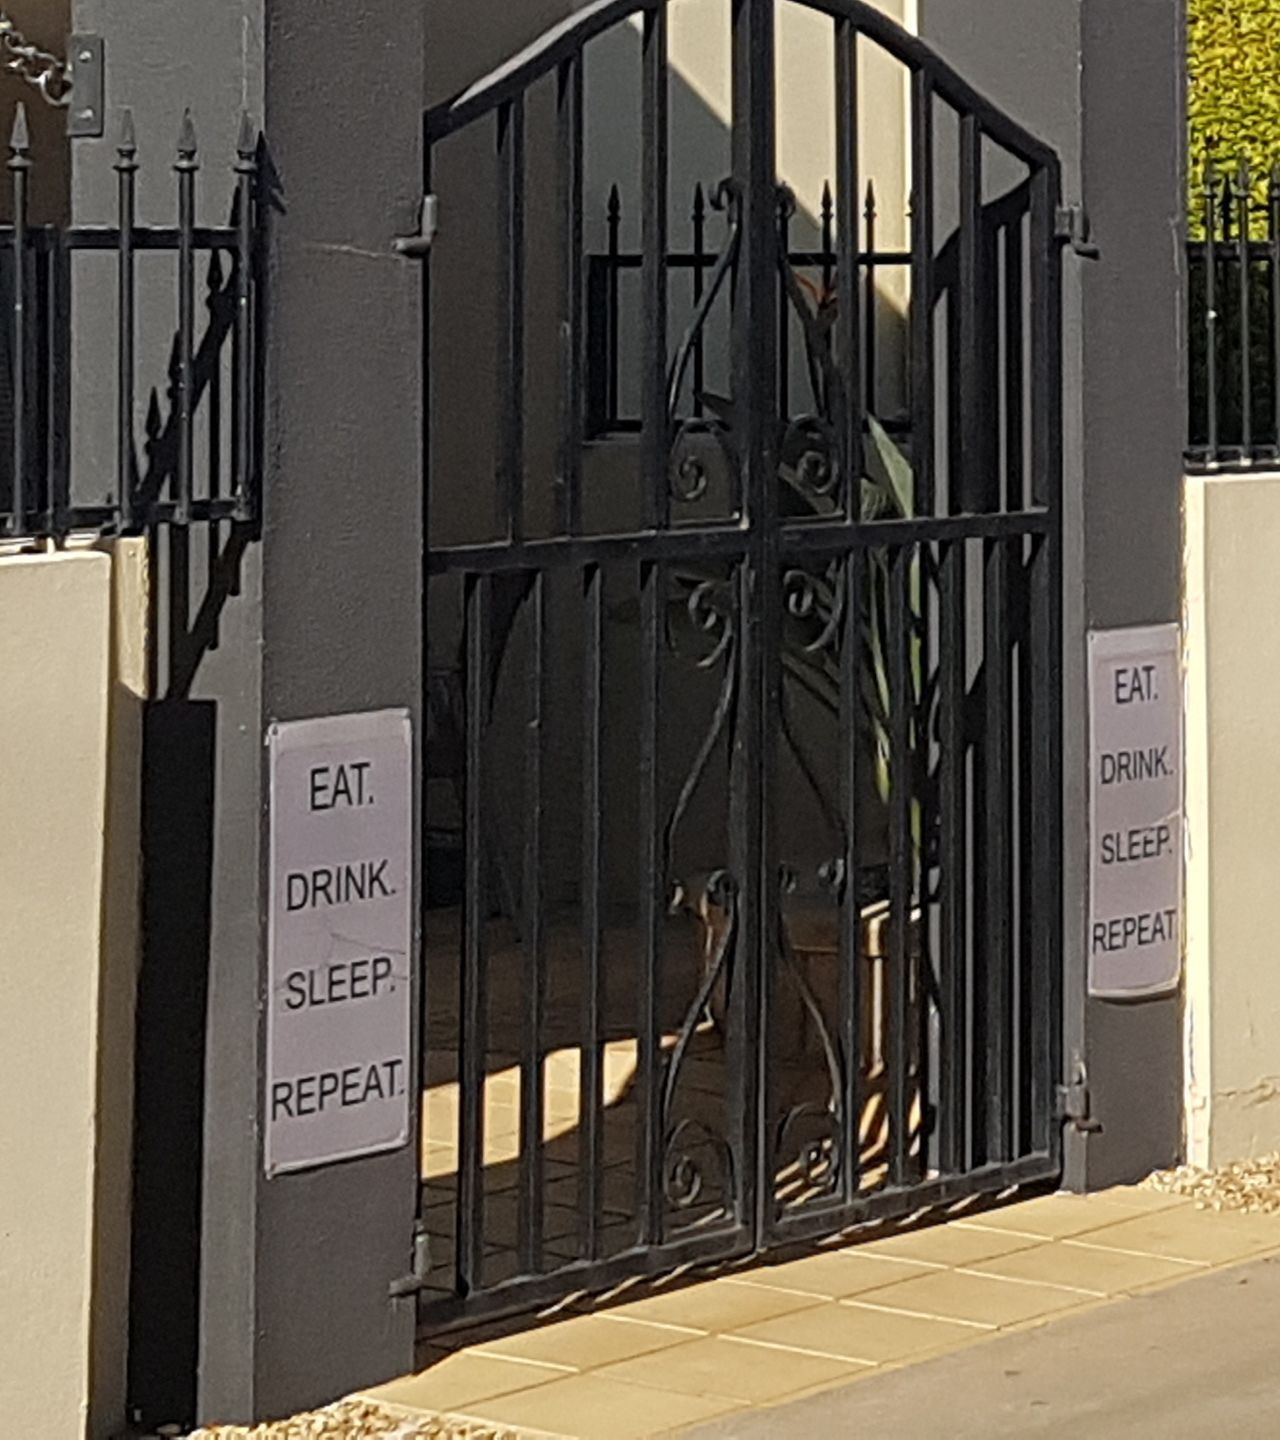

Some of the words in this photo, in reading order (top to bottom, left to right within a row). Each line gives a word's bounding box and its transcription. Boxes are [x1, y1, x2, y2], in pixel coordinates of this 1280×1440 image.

[1114, 665, 1159, 704] EAT.
[309, 761, 374, 812] EAT.
[1101, 746, 1174, 785] DRINK.
[1101, 824, 1173, 865] SLEEP.
[286, 859, 397, 912] DRINK.
[284, 957, 396, 1010] SLEEP.
[271, 1059, 405, 1122] REPEAT.
